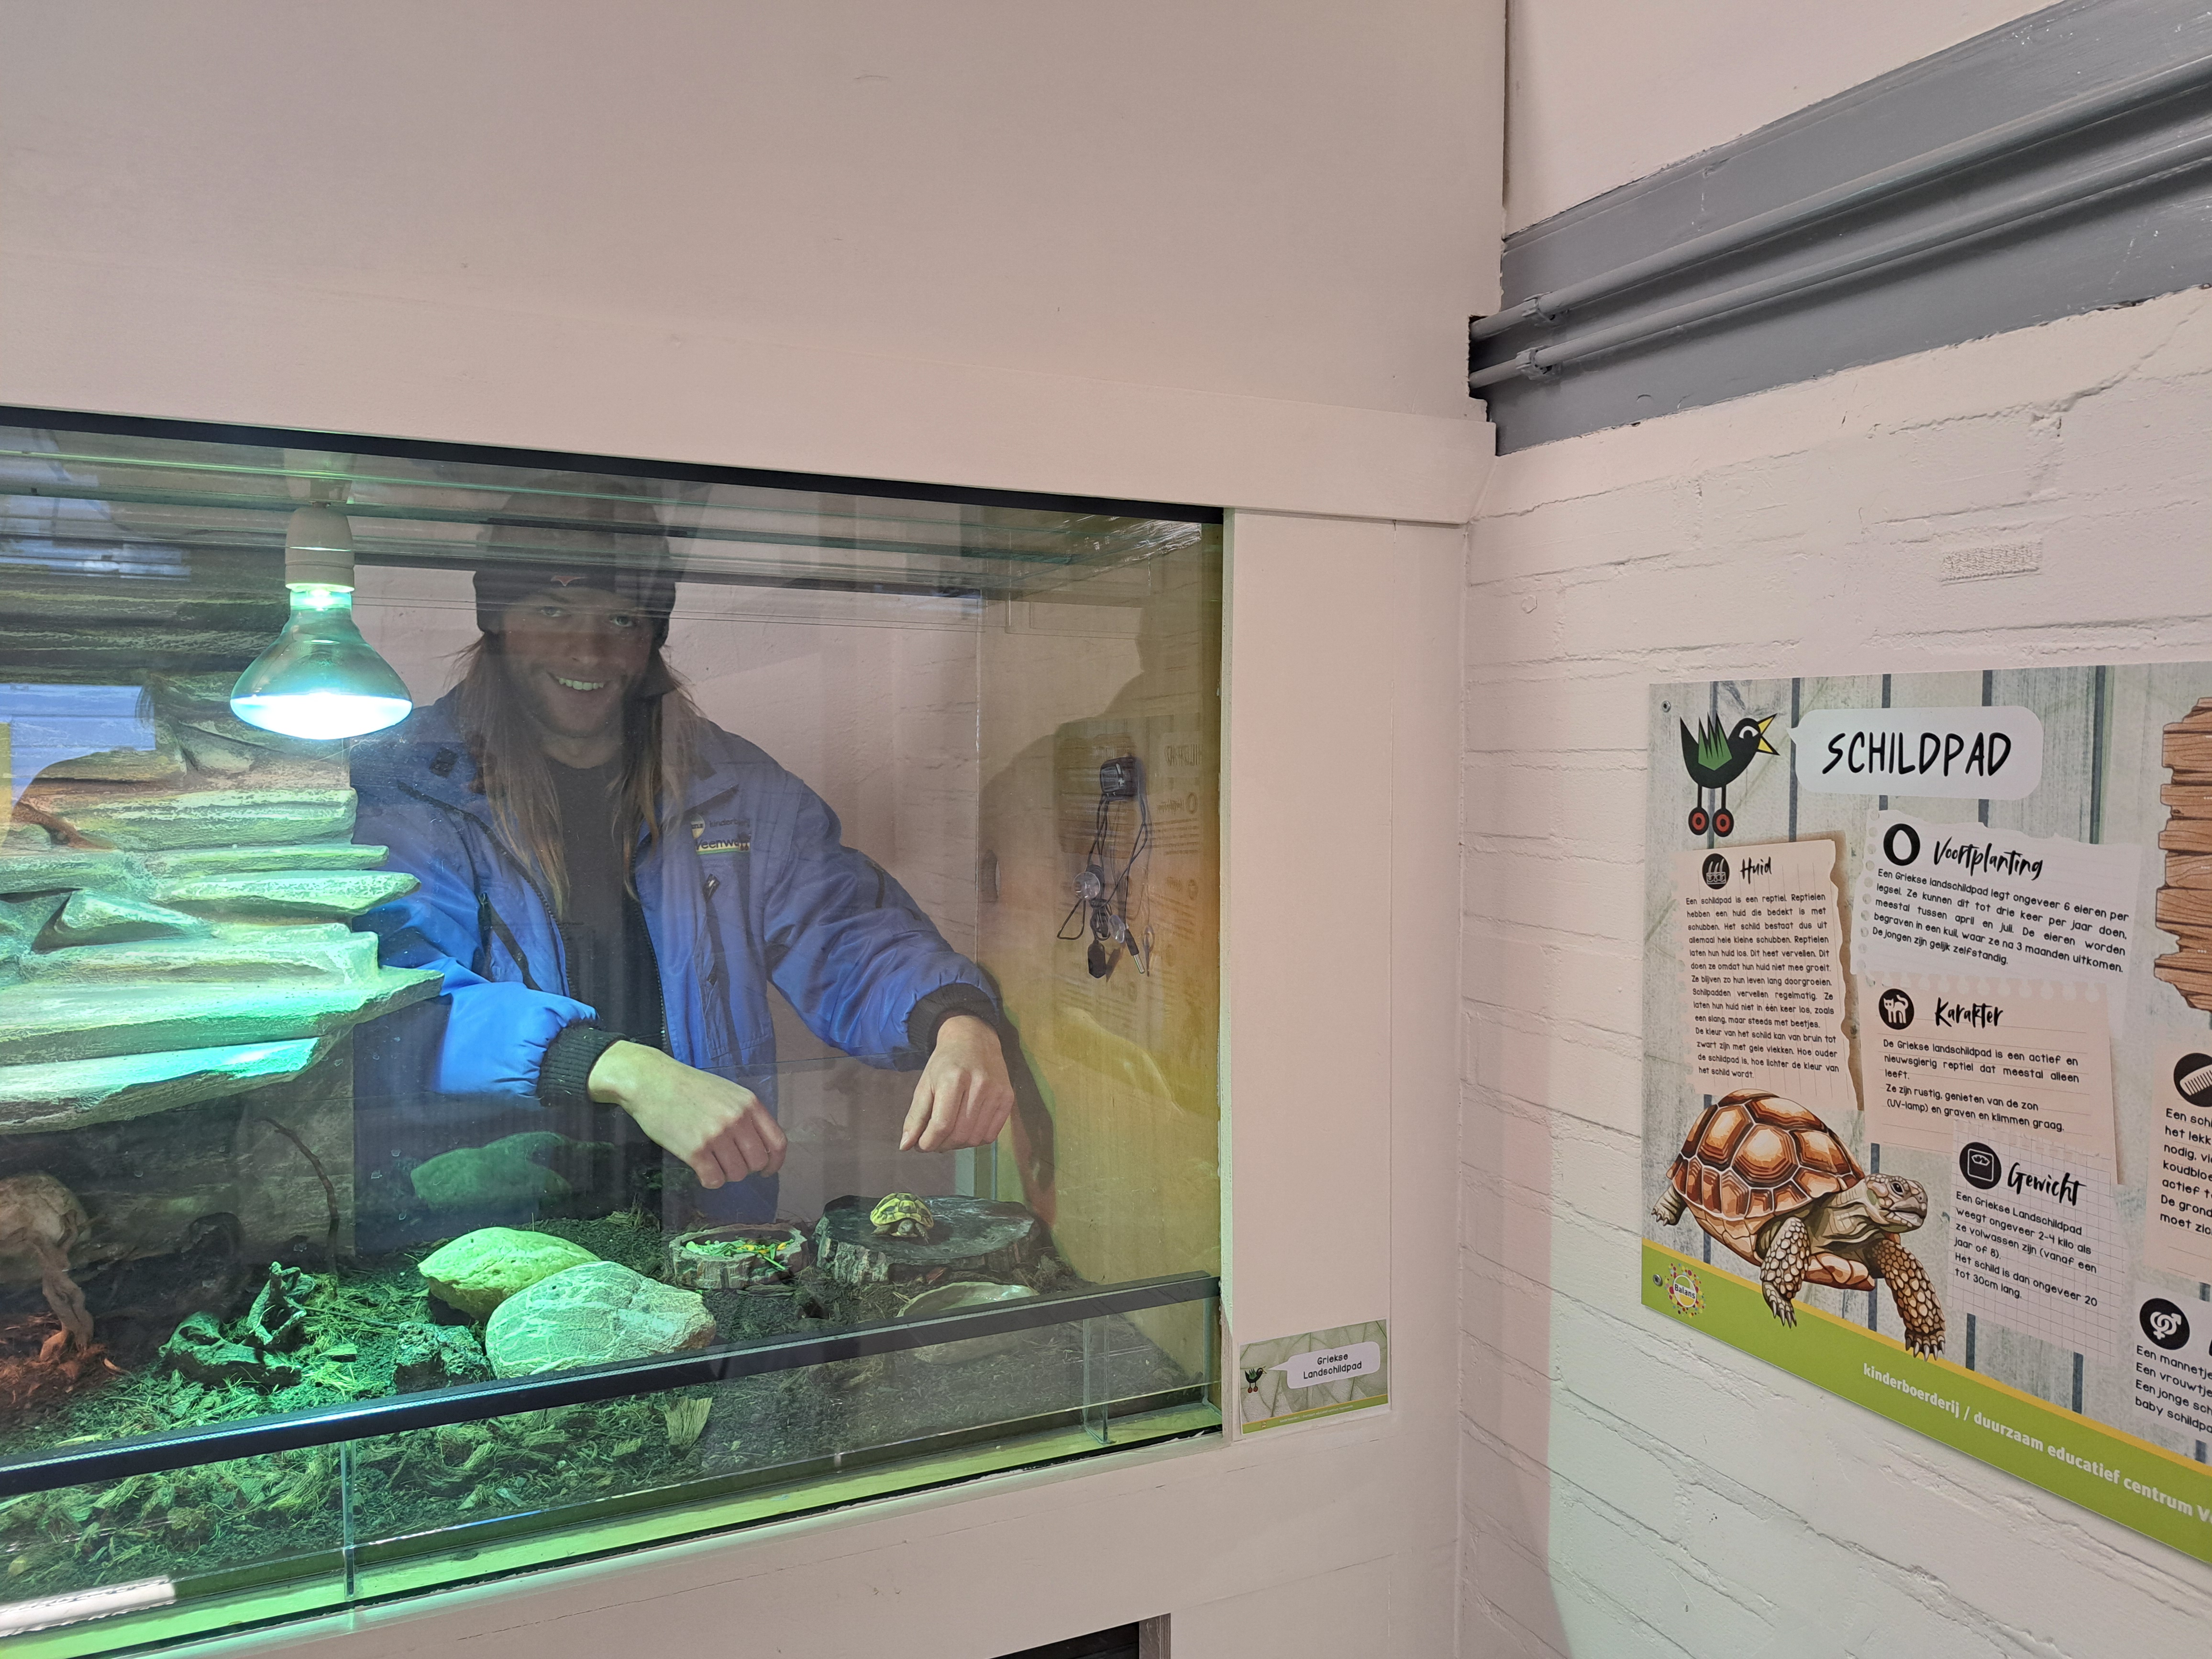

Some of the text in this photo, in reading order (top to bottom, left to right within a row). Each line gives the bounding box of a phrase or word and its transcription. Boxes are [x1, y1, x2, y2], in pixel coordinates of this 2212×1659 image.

[1822, 731, 2011, 776] SCHILDPAD
[1740, 856, 1772, 885] Huid
[1934, 836, 2043, 881] Voortplanting
[1701, 896, 1732, 906] schildpad
[1791, 893, 1825, 903] Reptielen
[1878, 868, 2129, 921] Een Griekse landschildpad legt ongeveer 6 eieren per
[1906, 888, 1917, 898] Ze
[1922, 891, 1952, 905] kunnen
[1957, 898, 1969, 908] dit
[1975, 901, 1991, 912] tot
[1996, 906, 2014, 917] drie
[2020, 910, 2043, 922] keer
[2048, 917, 2067, 927] per
[2070, 919, 2092, 931] jaar
[1794, 935, 1829, 945] Reptielen
[1872, 926, 1883, 936] De
[1883, 929, 1912, 943] jongen
[1913, 936, 1927, 947] zijn
[1929, 940, 1950, 952] gelijk
[1874, 912, 1913, 928] begraven
[1916, 920, 1922, 930] in
[1925, 924, 1941, 934] een
[1962, 931, 1985, 942] waar
[1988, 937, 2000, 946] ze
[2002, 940, 2013, 949] na
[2016, 941, 2022, 951] 3
[2025, 945, 2069, 961] maanden
[1875, 899, 1910, 912] meestal
[1917, 906, 1947, 919] tussen
[1955, 915, 1974, 925] april
[1982, 920, 1993, 929] en
[2022, 927, 2035, 937] De
[2044, 932, 2075, 946] eieren
[2085, 940, 2125, 956] worden
[1692, 988, 1731, 997] Schilpadden
[1824, 992, 1833, 1000] Ze
[1935, 997, 2003, 1029] Karakter
[1883, 1039, 2078, 1066] De Griekse landschildpad is een actief en
[1698, 1066, 1709, 1074] het
[1711, 1068, 1730, 1076] schild
[1884, 1054, 2079, 1083] nieuwsgierig reptiel dat meestal alleen
[1886, 1083, 1896, 1093] Ze
[1899, 1085, 1912, 1096] zijn
[1945, 1092, 1984, 1104] genieten
[1987, 1097, 2003, 1106] van
[2006, 1099, 2018, 1108] de
[2021, 1102, 2038, 1111] zon
[1887, 1098, 1928, 1113] (UV-lamp)
[1931, 1106, 1941, 1114] en
[1944, 1107, 1976, 1119] graven
[1978, 1112, 1989, 1120] en
[1991, 1112, 2030, 1126] klimmen
[2166, 1107, 2186, 1122] Een
[2165, 1125, 2185, 1139] het
[2007, 1162, 2087, 1206] Gewicht
[2162, 1179, 2200, 1195] actief
[1956, 1191, 2082, 1236] Een Griekse Landschildpad
[2161, 1194, 2175, 1206] De
[1956, 1207, 2091, 1254] weegt ongeveer 2-4 kilo als
[2160, 1213, 2212, 1235] moet zic
[1954, 1237, 1973, 1249] jaar
[1975, 1245, 1987, 1254] of
[1956, 1223, 2096, 1273] ze volwassen zijn (vanaf een
[1674, 1283, 1695, 1299] Balans
[1955, 1252, 2097, 1306] Het schild is dan ongeveer 20
[1955, 1268, 1970, 1280] tot
[1973, 1274, 1998, 1290] 30cm
[1317, 1353, 1349, 1365] Griekse
[2136, 1345, 2156, 1360] Een
[1304, 1361, 1362, 1379] Landschildpad
[2136, 1361, 2156, 1377] Een
[2135, 1379, 2155, 1395] Een
[2157, 1387, 2189, 1406] jonge
[2135, 1396, 2163, 1416] baby
[1863, 1363, 1960, 1419] kinderboerderij
[1963, 1406, 1971, 1421] /
[1973, 1411, 2044, 1452] duurzaam
[2047, 1445, 2121, 1484] educatief
[2124, 1478, 2193, 1516] centrum
